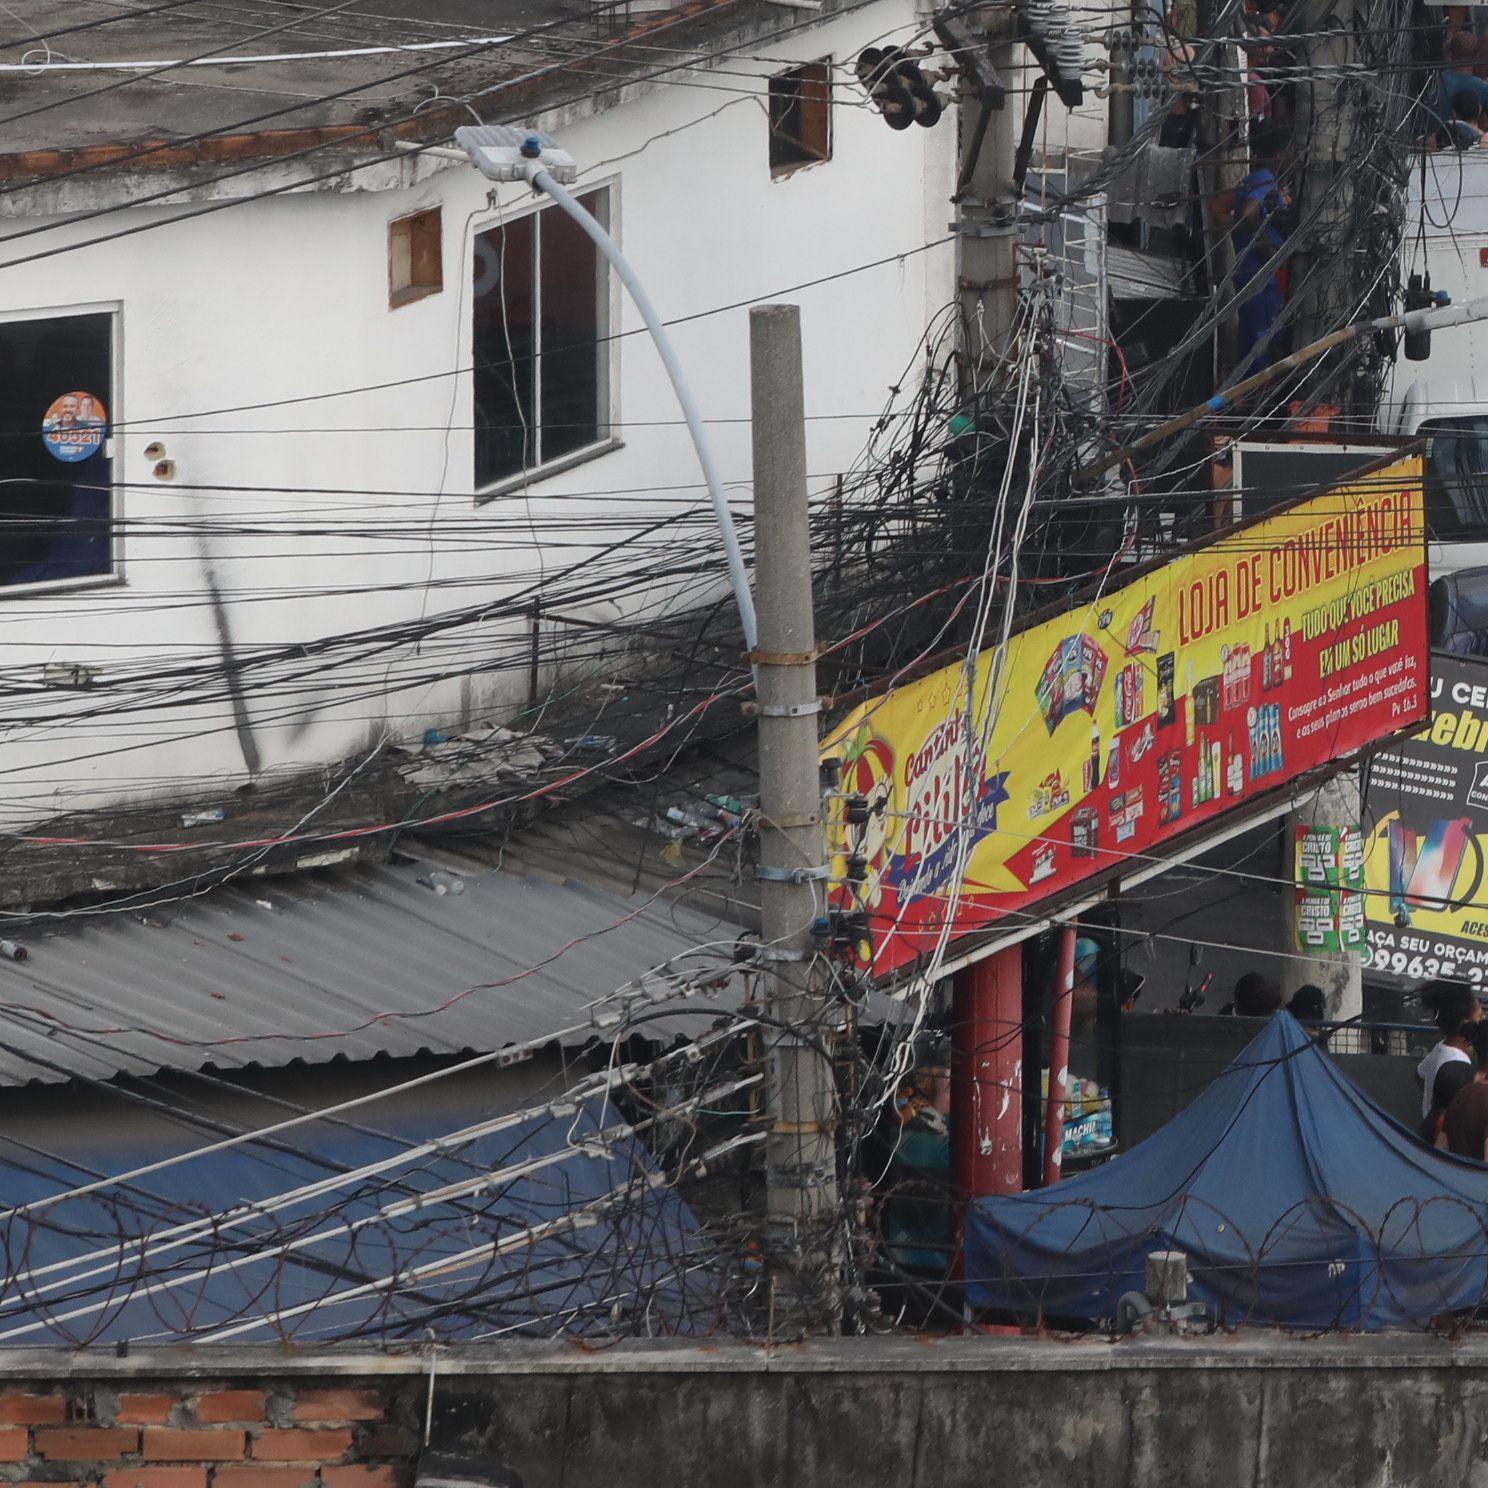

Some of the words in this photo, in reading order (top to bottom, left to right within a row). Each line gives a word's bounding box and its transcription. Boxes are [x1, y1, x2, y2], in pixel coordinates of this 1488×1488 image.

[1178, 568, 1230, 647] LOJA
[1236, 553, 1263, 621] DE
[1269, 490, 1414, 606] CONVENIÊNCIA
[1302, 610, 1328, 643] TUDO
[1328, 598, 1350, 629] QUE
[1351, 577, 1376, 620] VOCÊ
[1376, 569, 1415, 610] PRECISA
[1319, 645, 1333, 680] EM
[1334, 639, 1351, 673] UM
[1352, 624, 1366, 665] SÓ
[1366, 619, 1400, 658] LUGAR
[1327, 682, 1351, 702] Senhor
[1352, 673, 1368, 691] tudo
[1374, 668, 1387, 684] que
[1400, 937, 1430, 954] SEU
